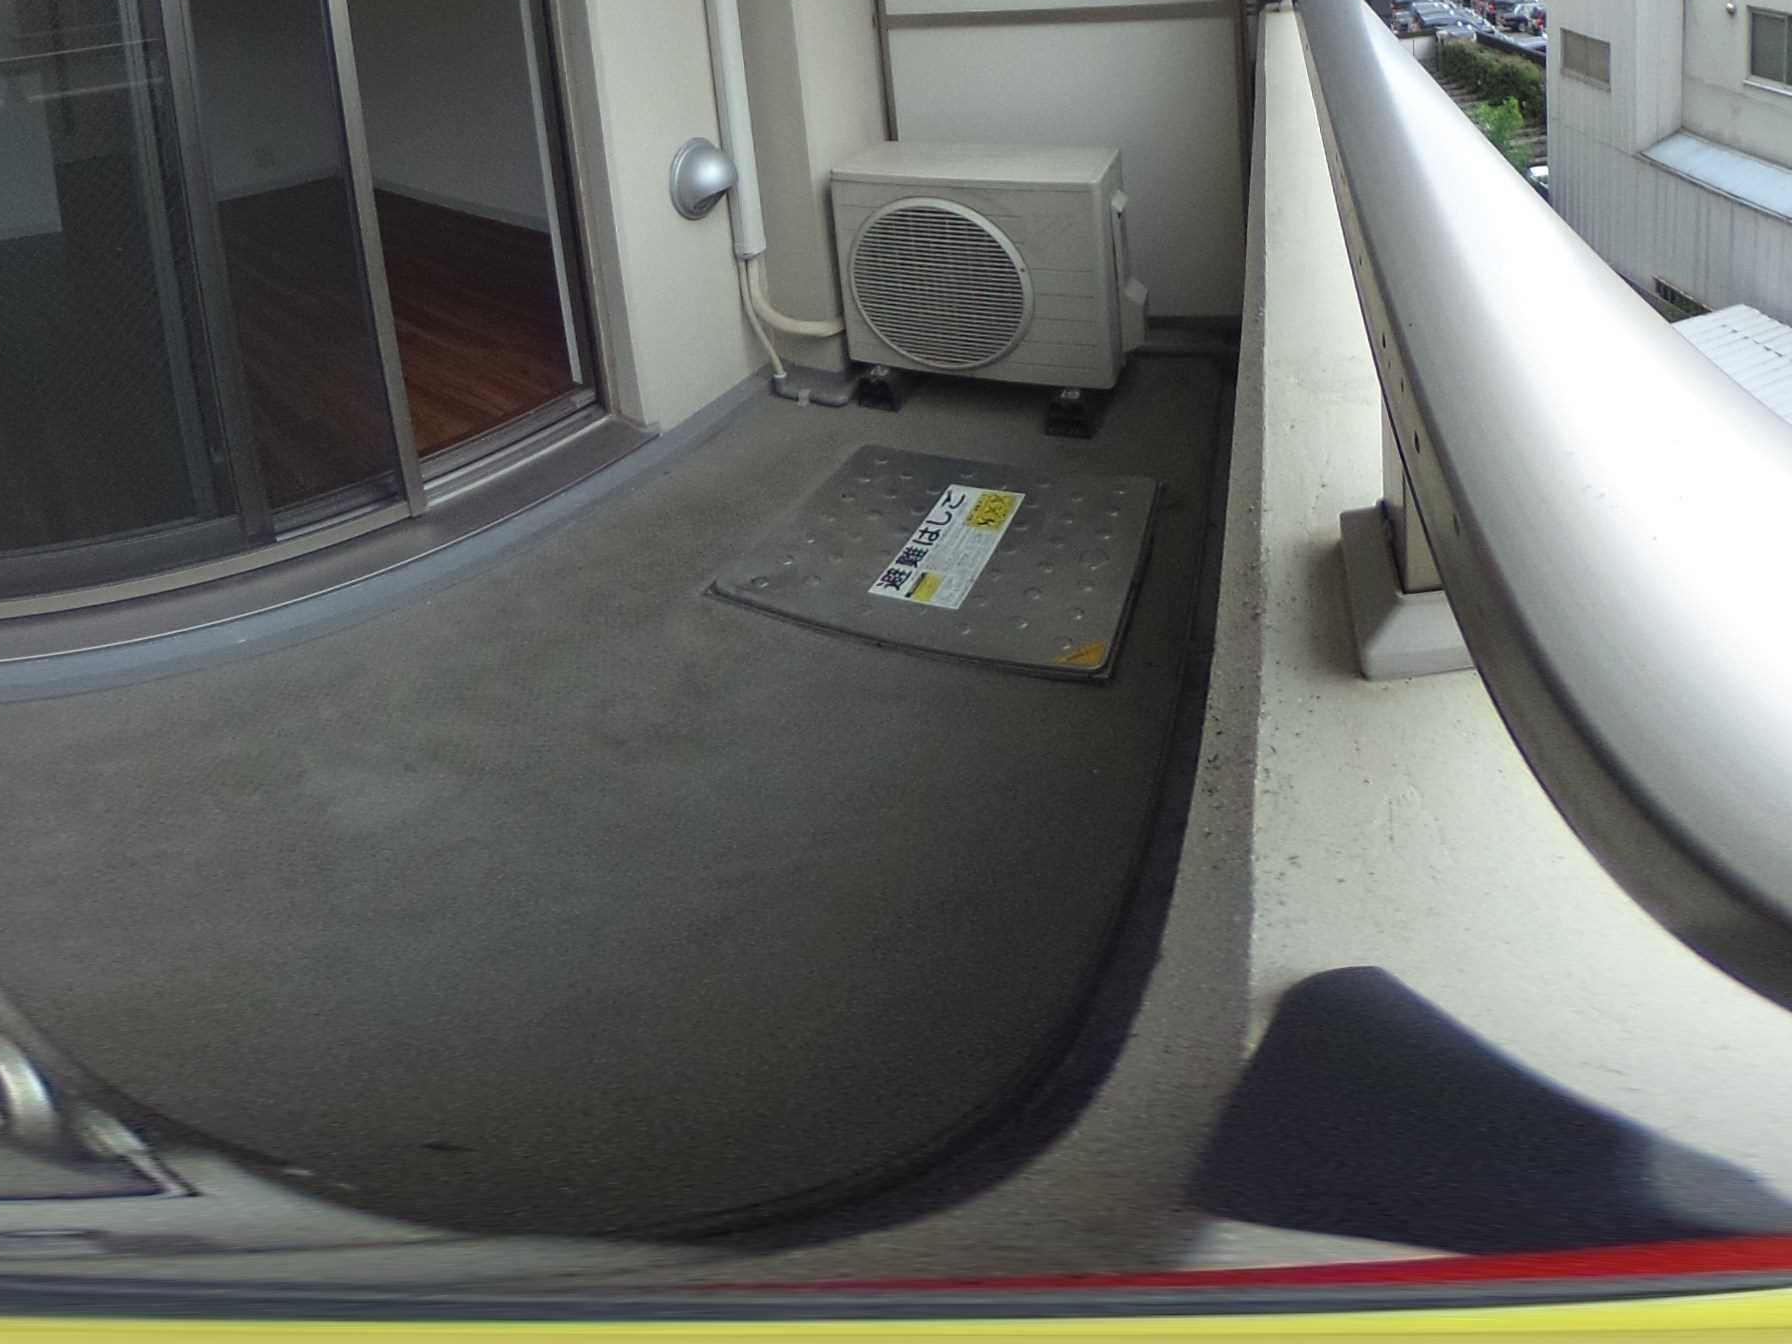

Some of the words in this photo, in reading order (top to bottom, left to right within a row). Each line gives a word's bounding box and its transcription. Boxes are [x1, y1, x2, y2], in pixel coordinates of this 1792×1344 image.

[877, 490, 966, 591] 避難はしご
